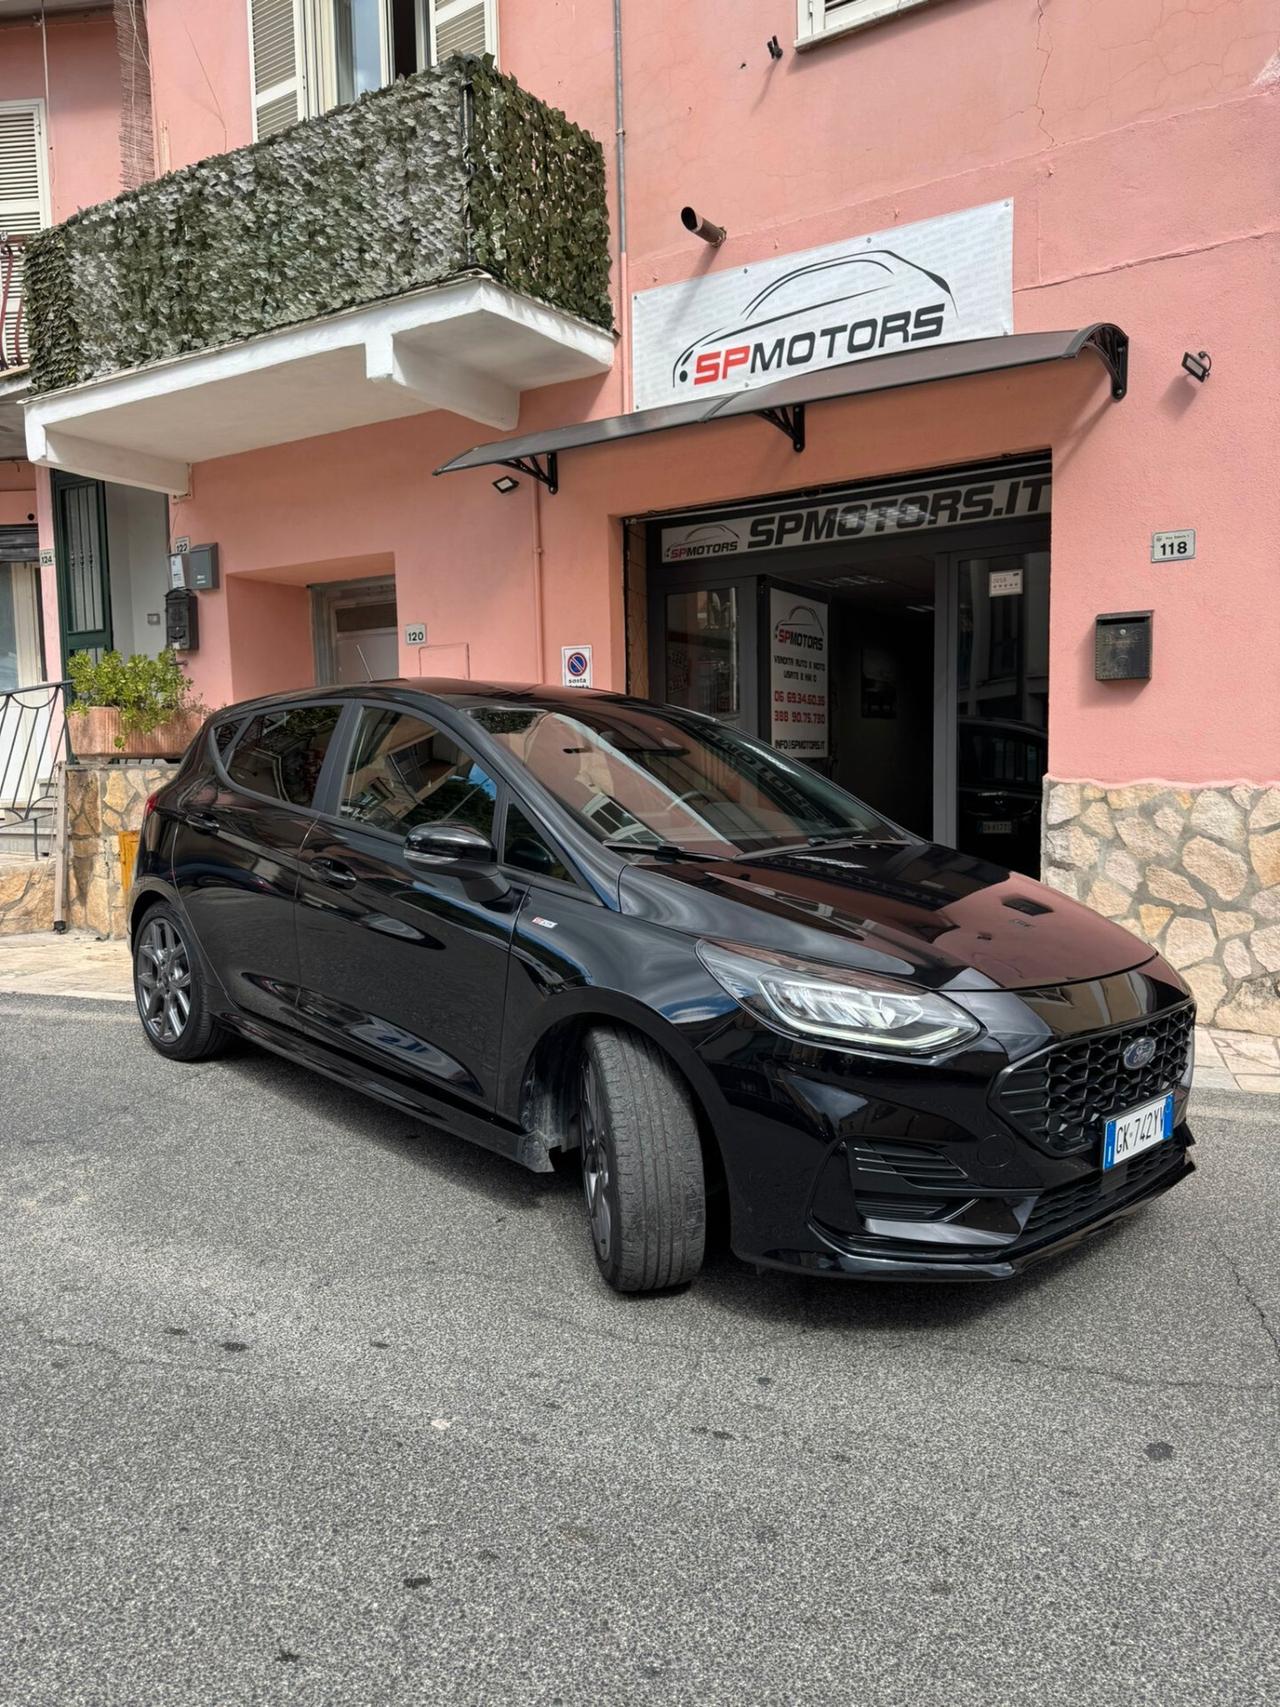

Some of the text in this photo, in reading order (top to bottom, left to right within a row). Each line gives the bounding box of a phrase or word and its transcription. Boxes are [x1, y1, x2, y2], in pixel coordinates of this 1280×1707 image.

[693, 303, 945, 385] SPMOTORS
[747, 477, 1050, 548] SPMOTORS.IT
[670, 541, 738, 560] SPMOTORS
[1160, 541, 1188, 556] 118
[408, 631, 424, 642] 120
[778, 629, 824, 651] SPMOTORS
